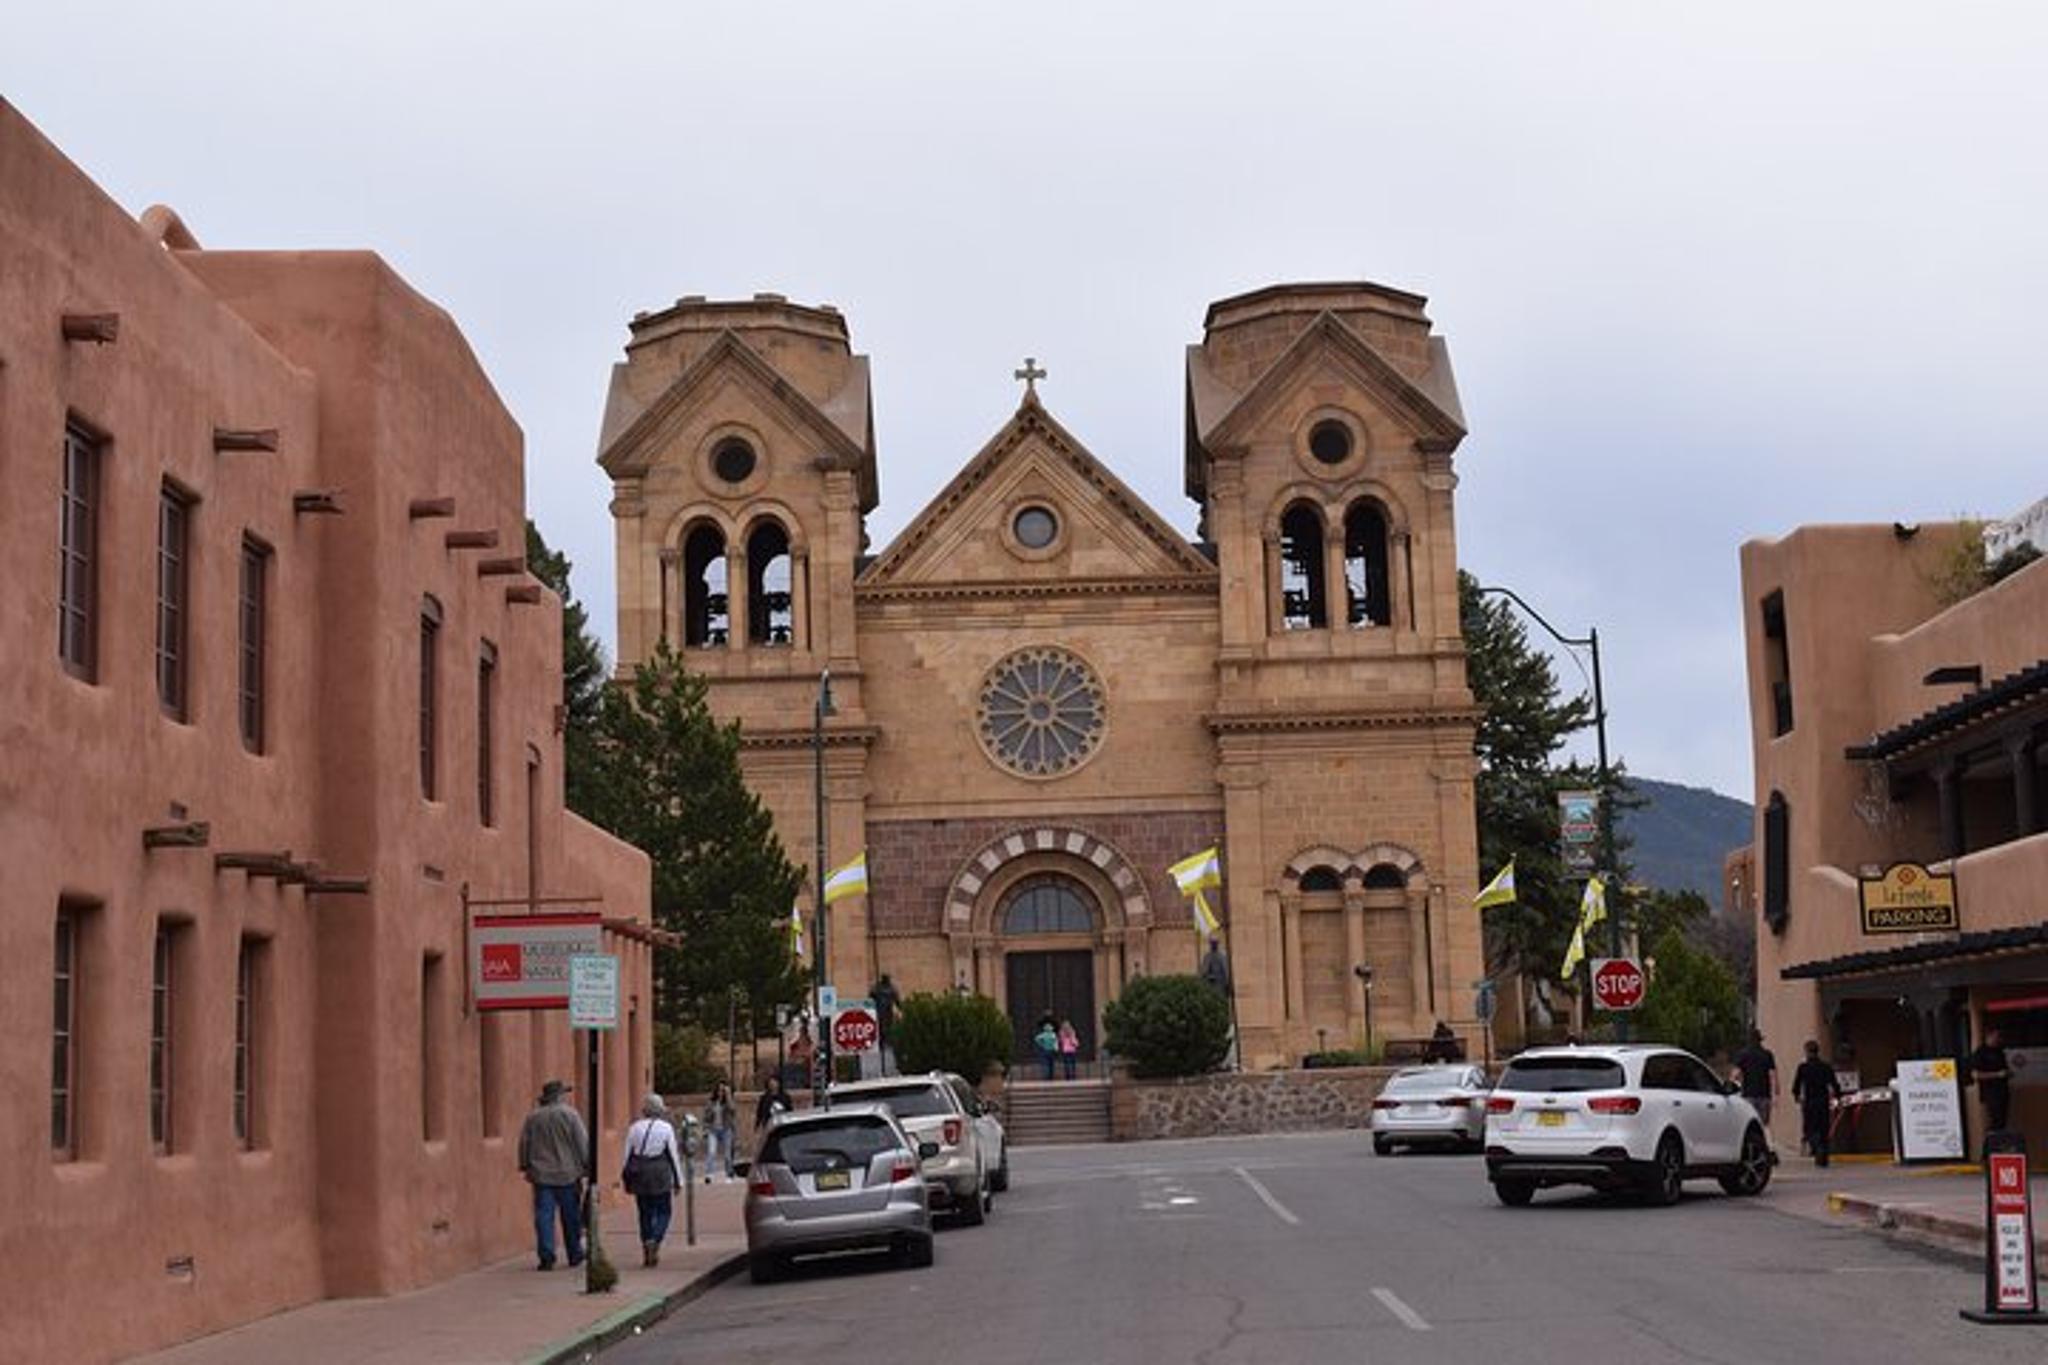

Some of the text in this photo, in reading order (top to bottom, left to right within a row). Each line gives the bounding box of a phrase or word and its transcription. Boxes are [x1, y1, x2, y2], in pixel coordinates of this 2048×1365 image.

[1872, 908, 1947, 926] PARKING
[1598, 974, 1640, 995] STOP
[838, 1022, 874, 1041] STOP
[1999, 1167, 2018, 1187] NO
